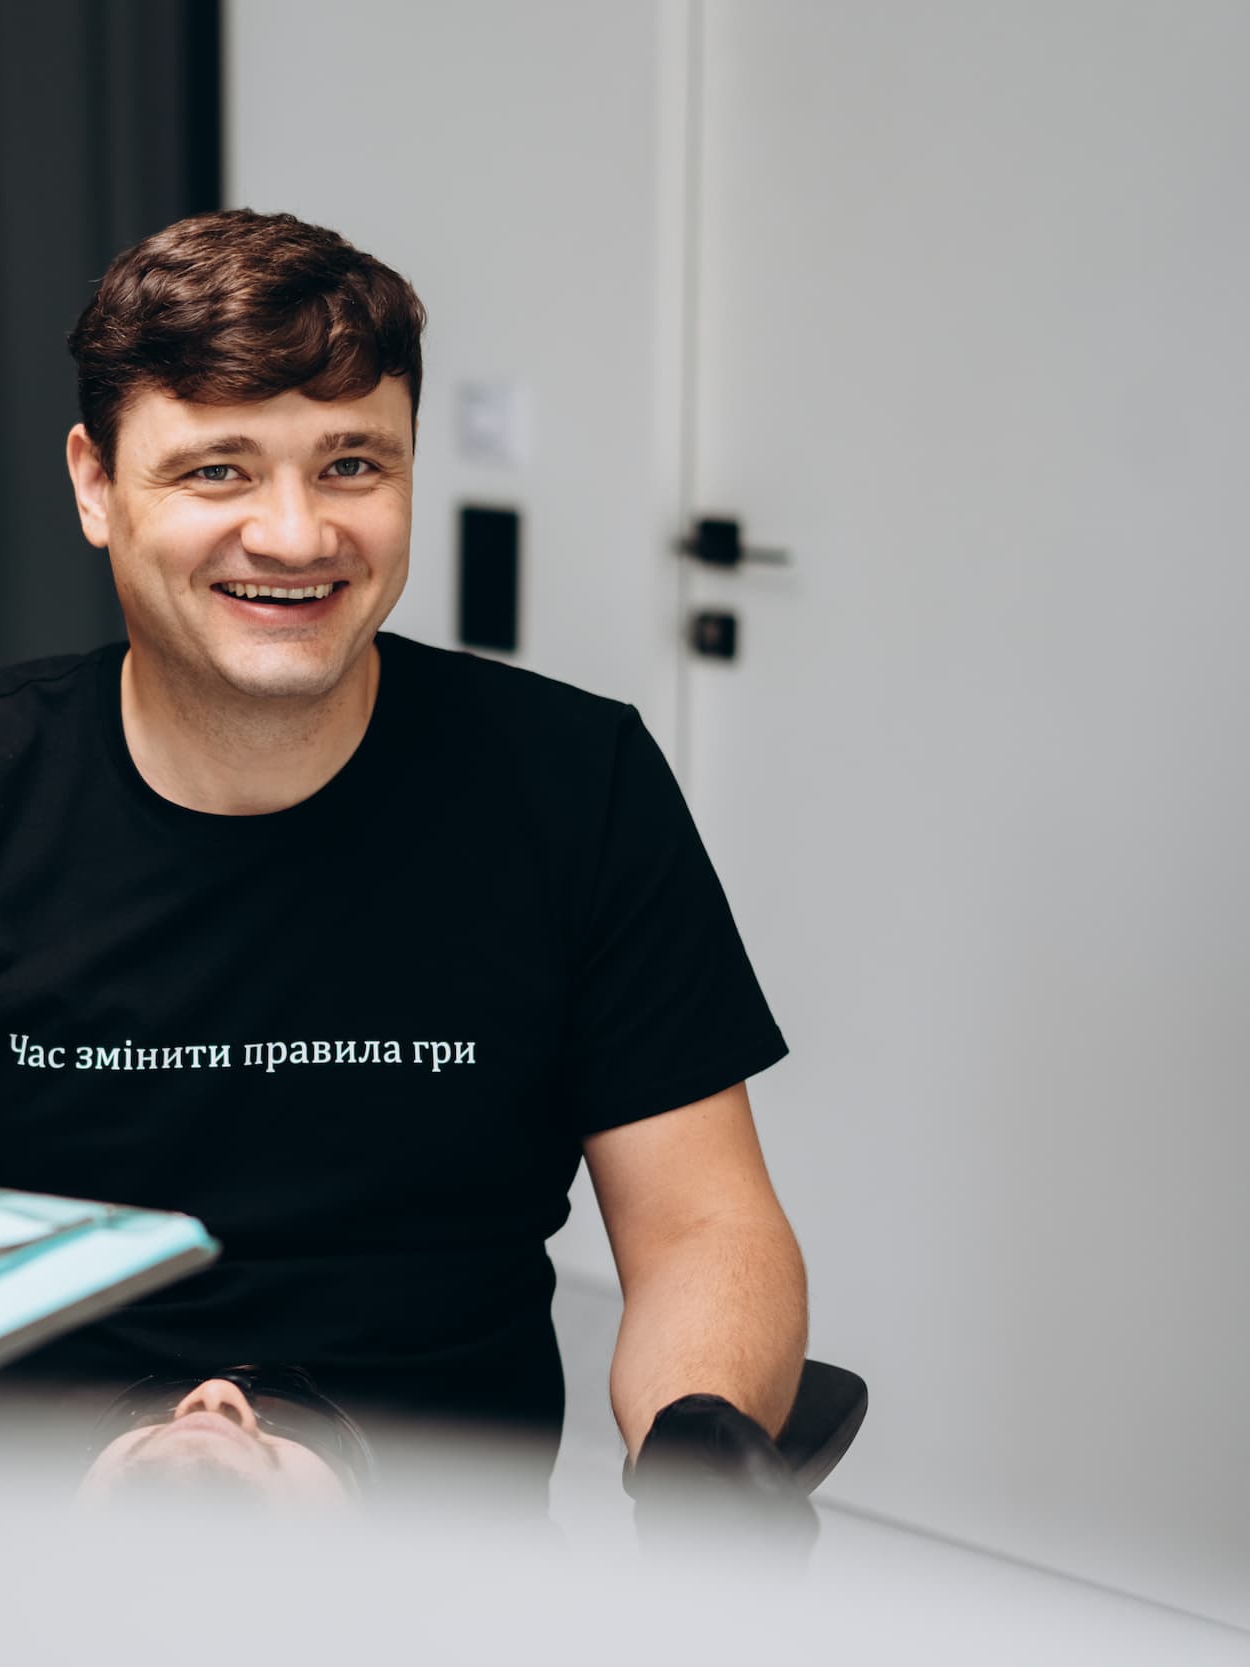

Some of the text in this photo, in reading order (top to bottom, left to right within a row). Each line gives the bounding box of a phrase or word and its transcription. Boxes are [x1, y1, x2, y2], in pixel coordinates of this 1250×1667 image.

[9, 1033, 476, 1073] Час змінити правила гри
